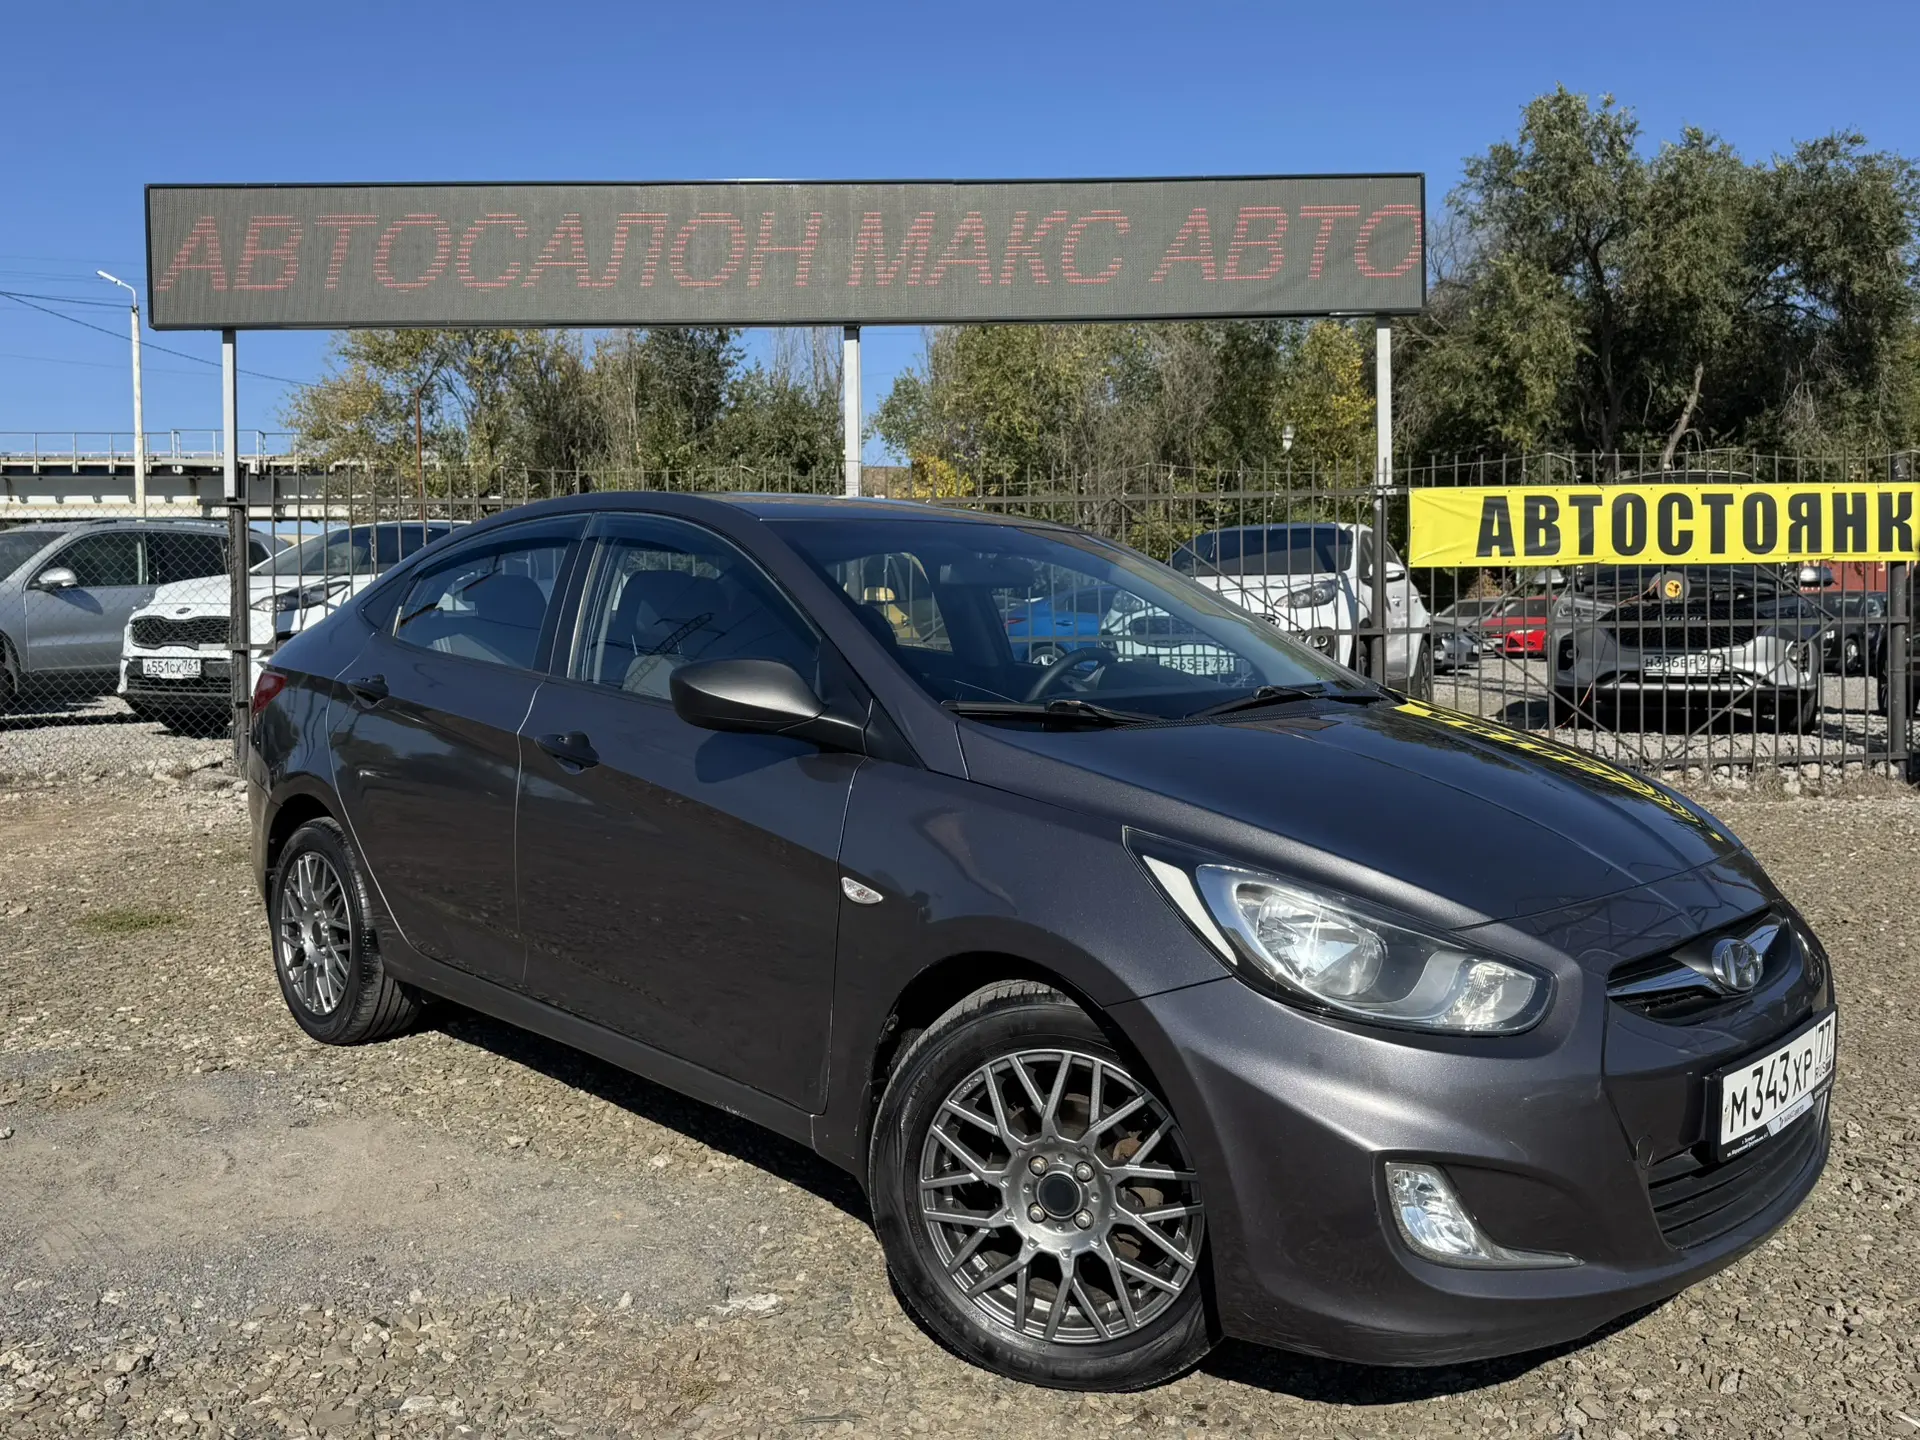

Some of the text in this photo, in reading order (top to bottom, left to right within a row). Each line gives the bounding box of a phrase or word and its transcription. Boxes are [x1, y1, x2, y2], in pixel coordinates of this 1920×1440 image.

[155, 204, 1422, 292] АВТОСАЛОН МАКС АВТО
[1475, 491, 1914, 558] АВТОСТОЯНК
[1730, 1048, 1813, 1134] М343ХР
